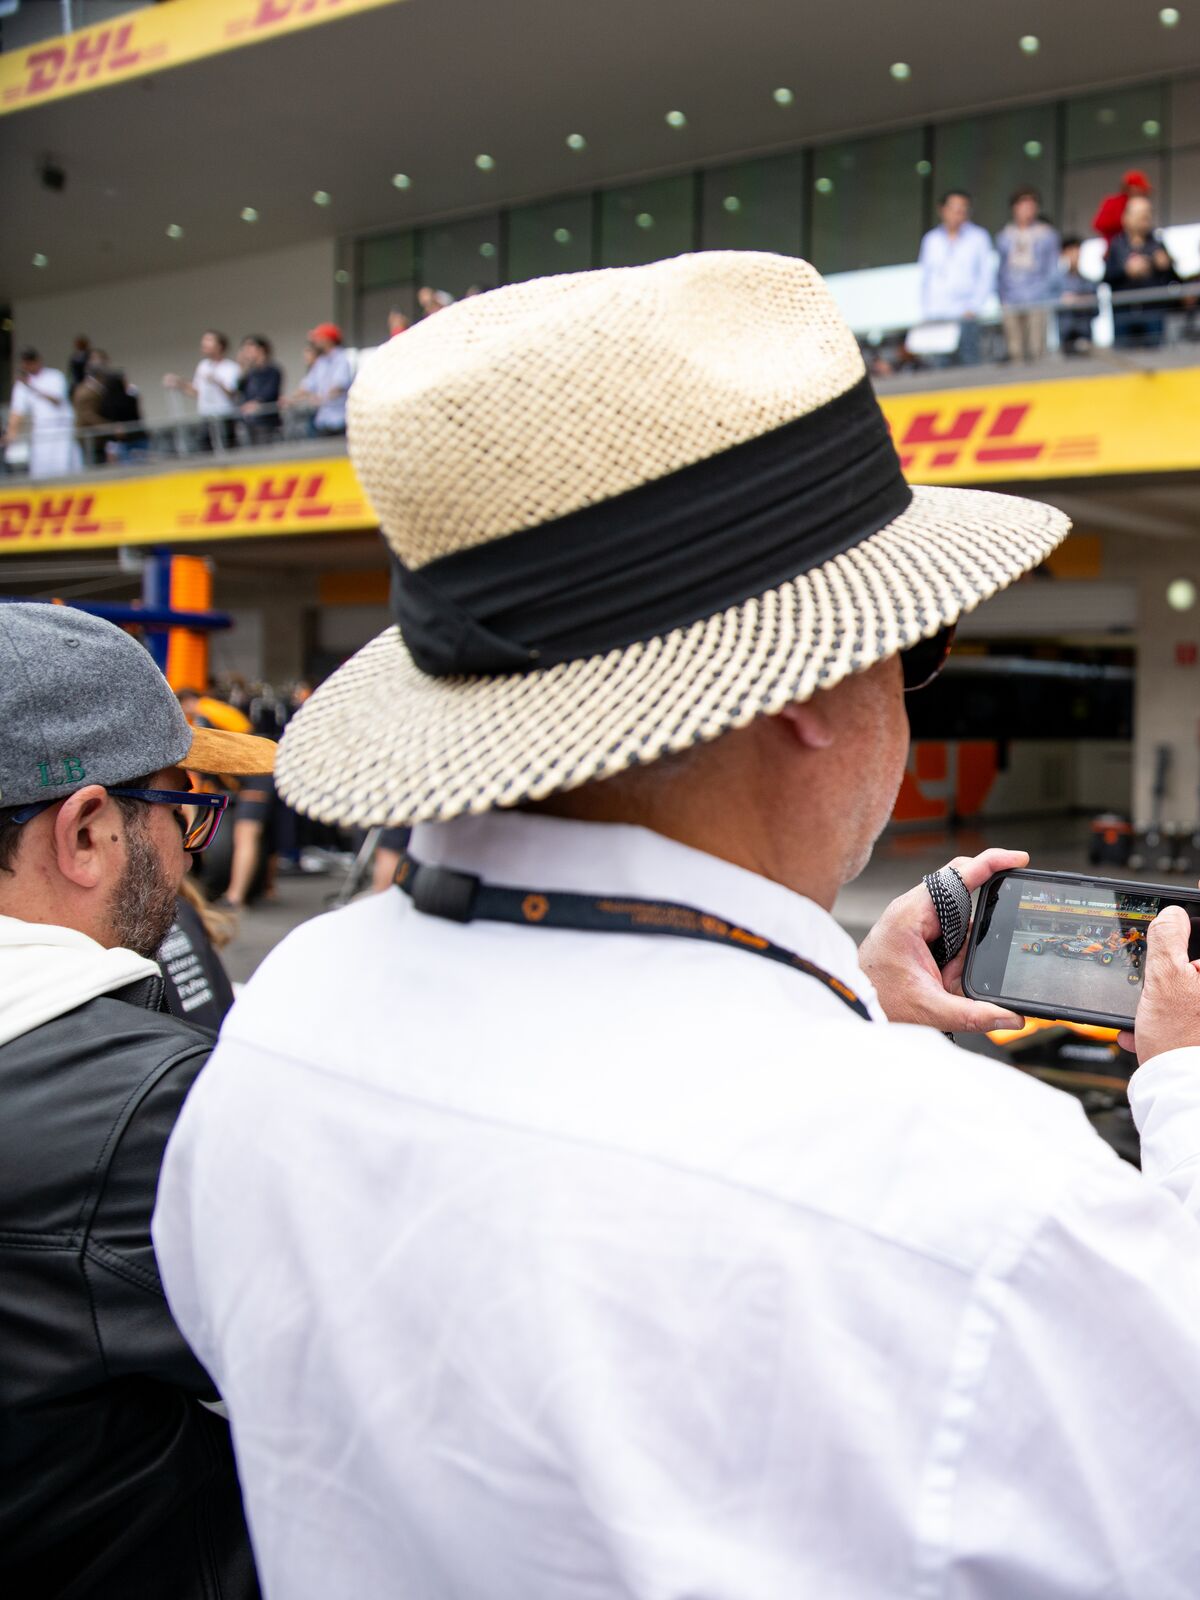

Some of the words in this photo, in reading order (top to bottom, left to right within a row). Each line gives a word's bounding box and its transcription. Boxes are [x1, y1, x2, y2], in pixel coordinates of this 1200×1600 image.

[26, 22, 140, 95] DHL
[898, 402, 1046, 469] HL
[0, 494, 100, 539] DHL
[202, 475, 332, 524] DHL
[36, 757, 86, 786] LB
